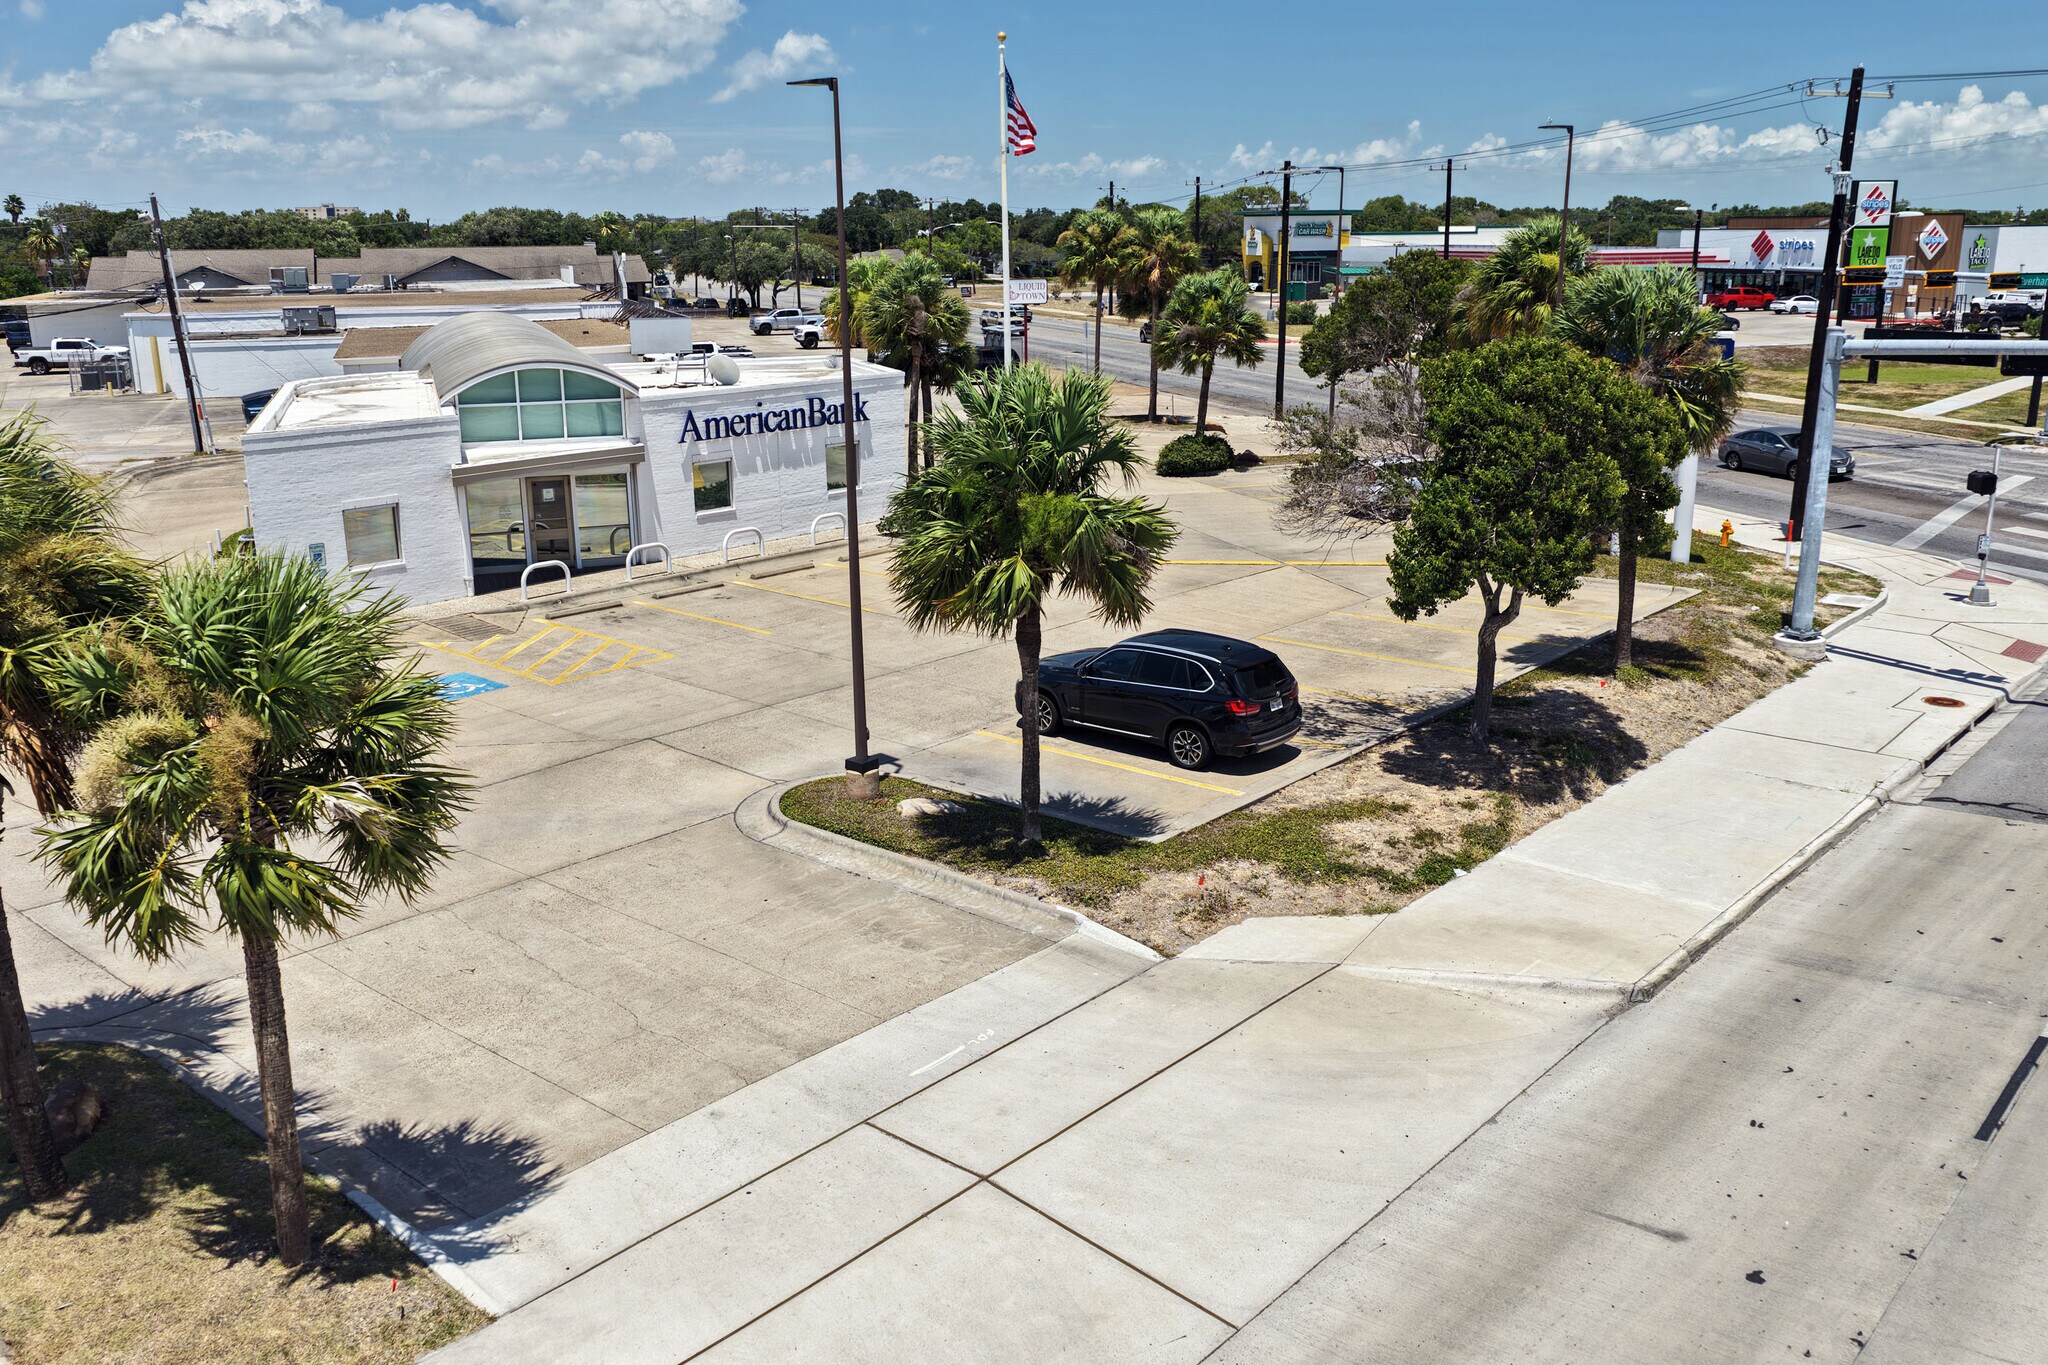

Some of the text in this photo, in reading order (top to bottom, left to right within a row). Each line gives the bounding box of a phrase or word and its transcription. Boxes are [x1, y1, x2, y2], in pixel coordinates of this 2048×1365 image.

[1861, 199, 1890, 211] stripes
[1779, 238, 1814, 253] stripes
[1857, 245, 1881, 259] LAREDO
[1858, 258, 1878, 266] TACO
[1970, 257, 1988, 266] TACO
[1019, 283, 1046, 291] LIQUID
